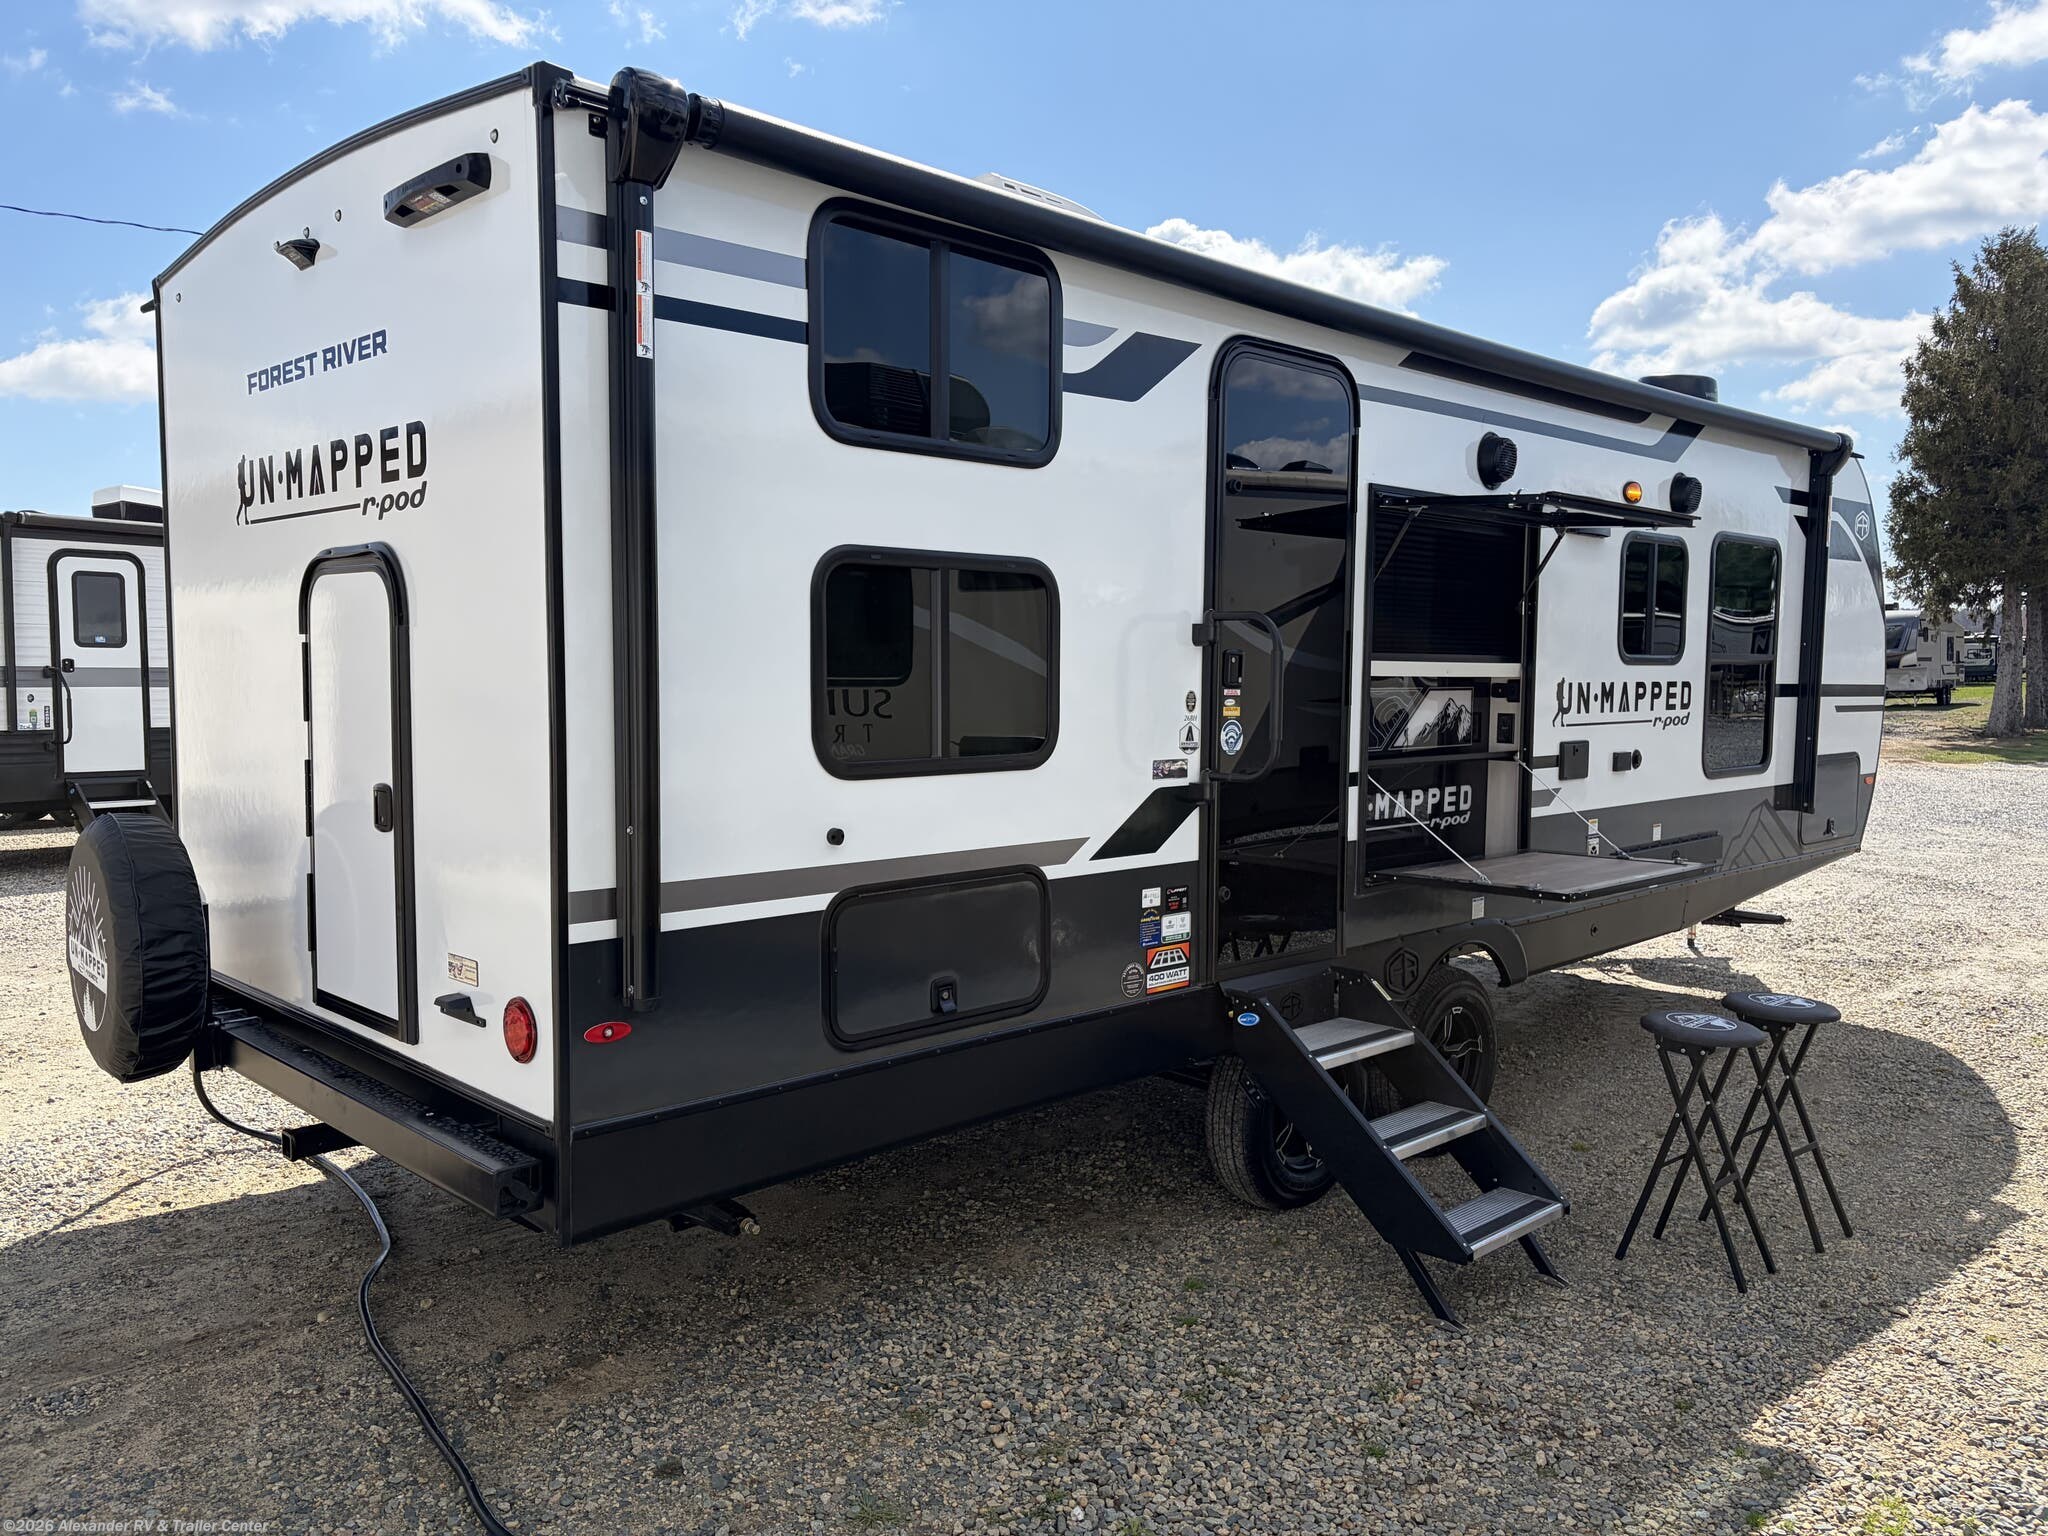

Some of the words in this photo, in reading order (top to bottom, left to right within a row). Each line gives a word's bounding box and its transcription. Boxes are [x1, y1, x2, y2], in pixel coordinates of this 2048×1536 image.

[247, 352, 318, 395] FOREST
[322, 329, 388, 372] RIVER
[1148, 973, 1165, 982] 400
[1165, 968, 1188, 979] WATT
